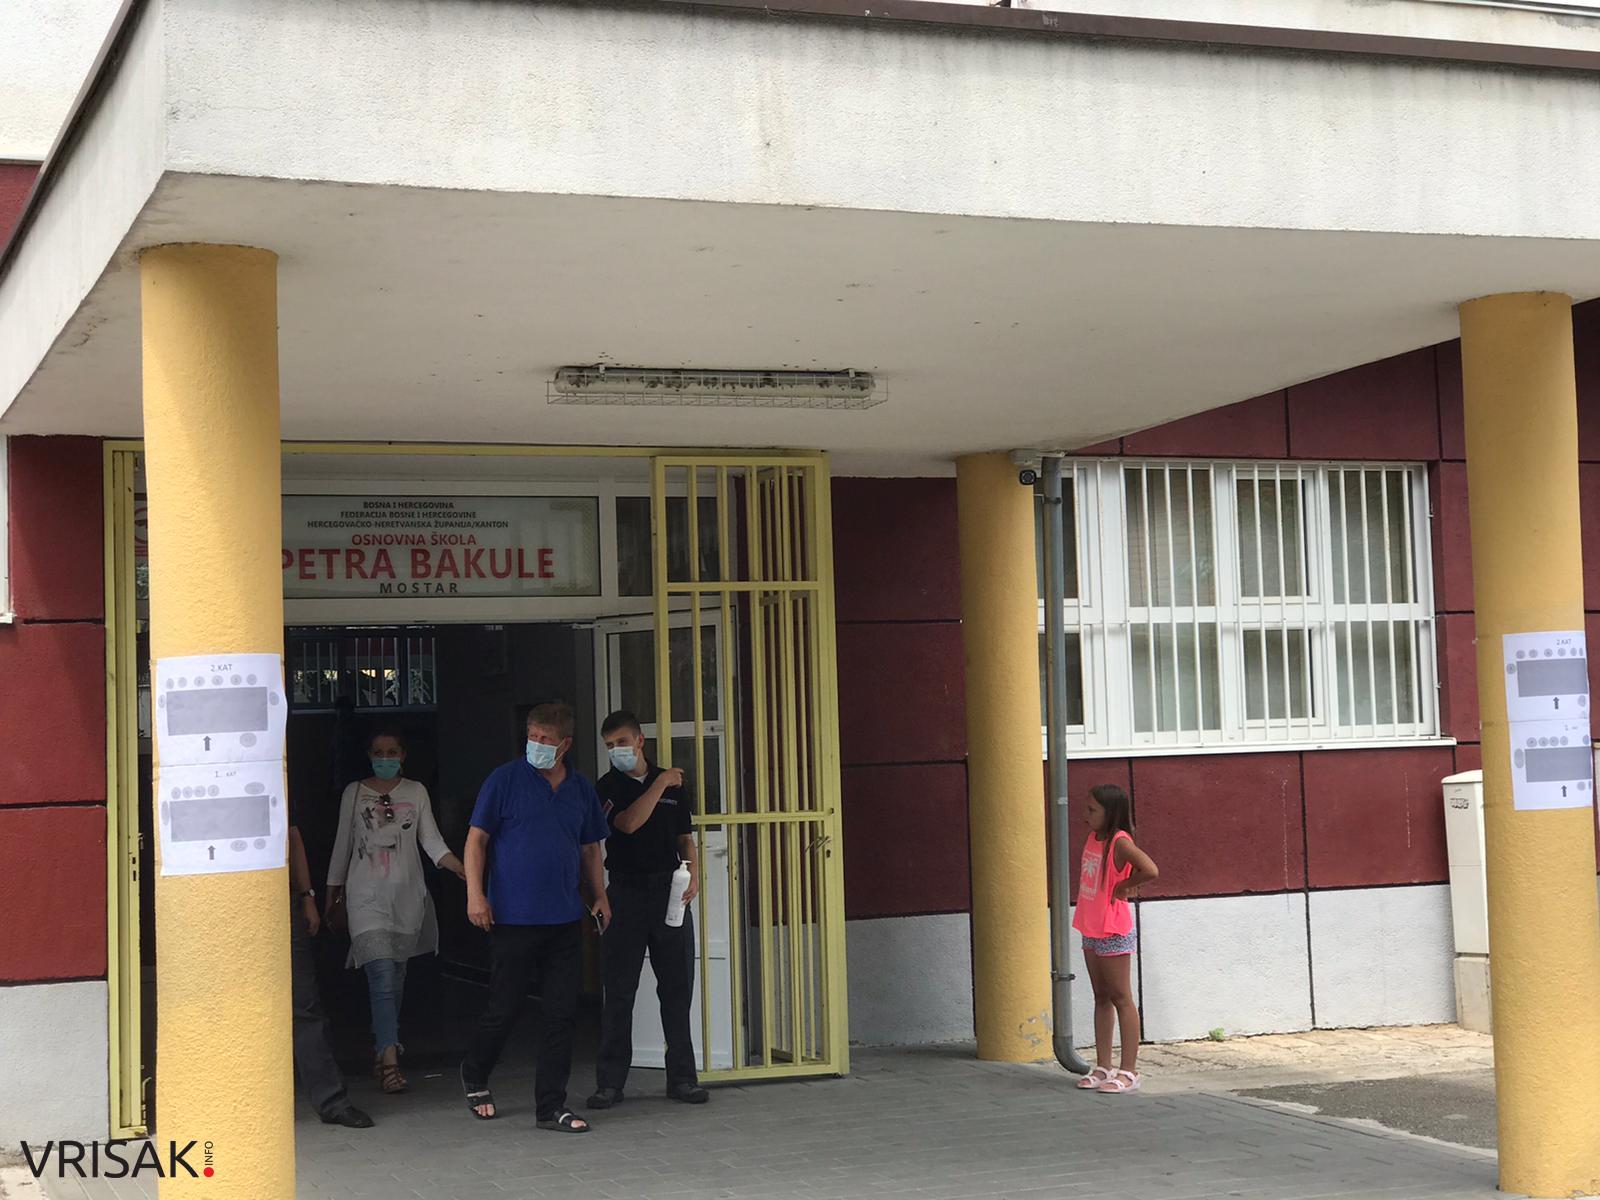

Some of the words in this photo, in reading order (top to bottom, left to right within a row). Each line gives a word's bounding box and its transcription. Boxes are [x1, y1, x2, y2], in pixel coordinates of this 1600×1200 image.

[363, 501, 391, 509] BOSNA
[398, 501, 454, 509] HERCEGOVINA
[340, 511, 387, 519] FEDERACIJA
[389, 511, 416, 519] BOSNE
[422, 511, 477, 519] HERCEGOVINE
[433, 519, 509, 528] ŽUPANIJA/KANTON
[351, 534, 426, 546] OSNOVNA
[430, 531, 477, 546] ŠKOLA
[410, 548, 555, 579] BAKULE
[379, 582, 459, 594] MOSTAR
